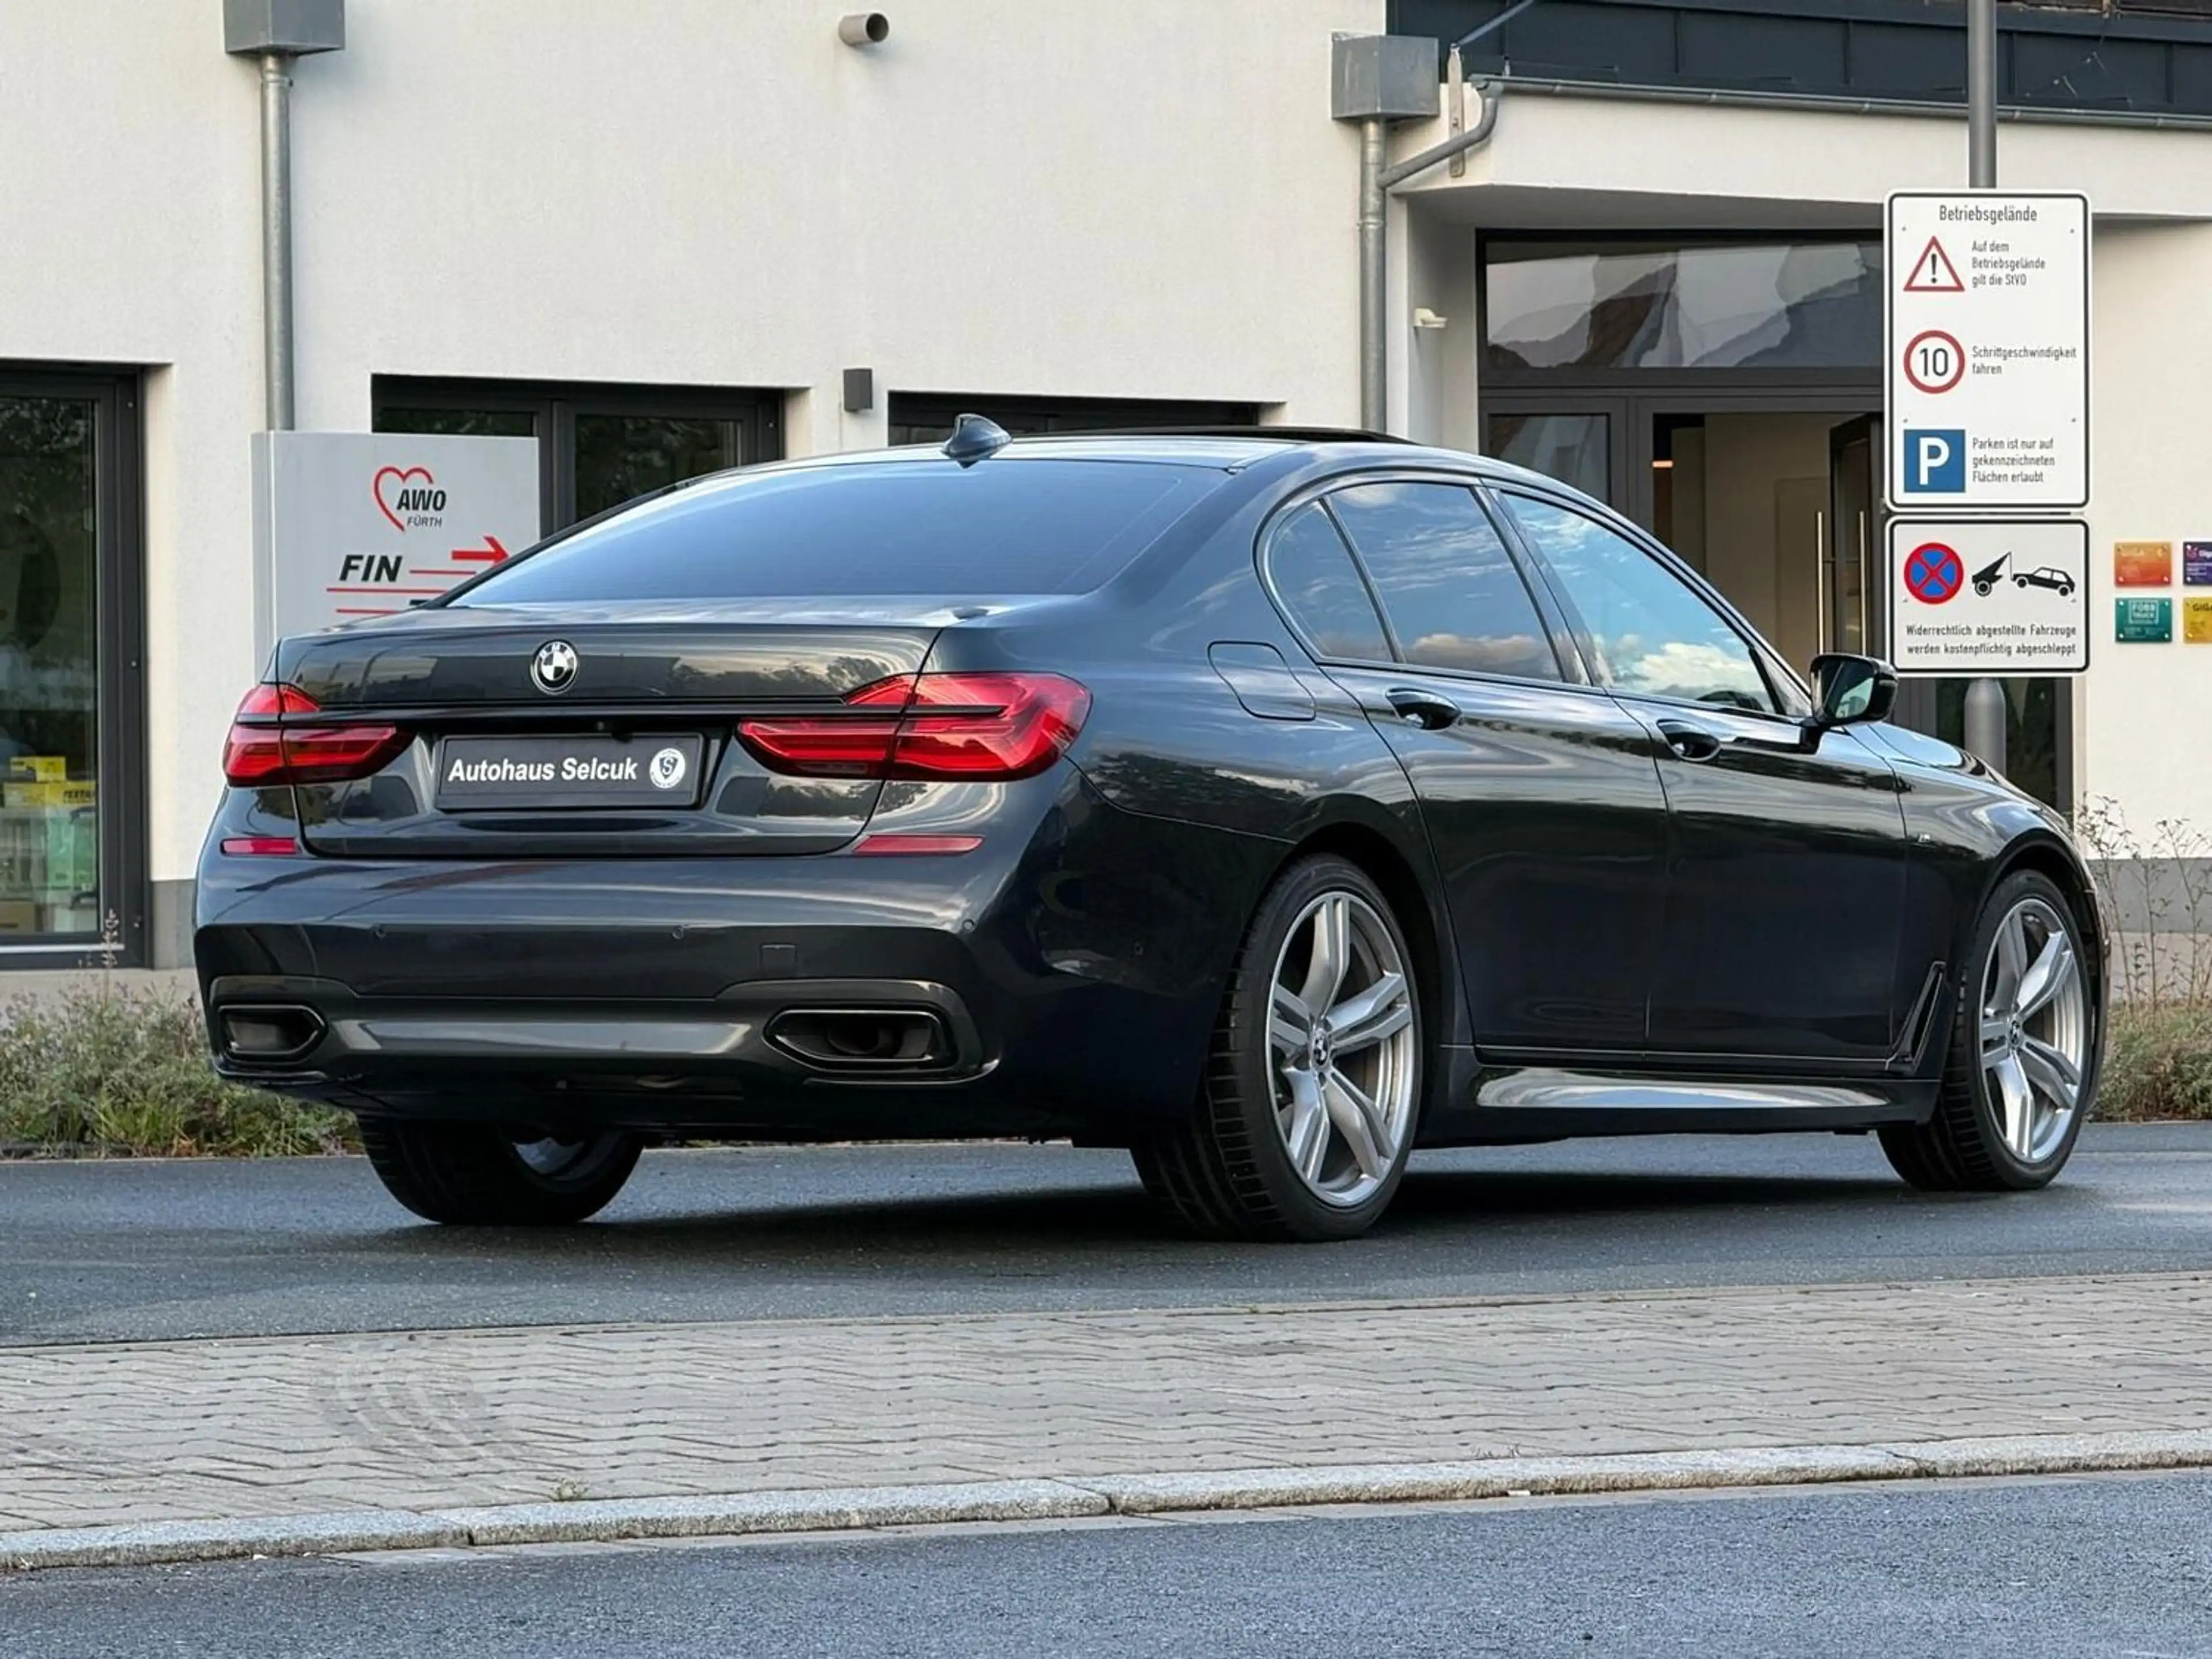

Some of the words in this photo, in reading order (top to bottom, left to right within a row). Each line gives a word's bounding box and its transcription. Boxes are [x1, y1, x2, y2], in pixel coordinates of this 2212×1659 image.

[1940, 204, 2037, 225] Betriebsgelände
[1972, 241, 1987, 252] Auf
[1990, 241, 2009, 252] dem
[1972, 257, 2046, 271] Betriebsgelände
[1972, 274, 1986, 288] gilt
[1989, 274, 2002, 285] die
[2005, 274, 2027, 286] StVO
[1972, 346, 2076, 361] Schrittgeschwindigkeit
[1918, 347, 1950, 377] 10
[1972, 363, 2002, 374] fahren
[1972, 437, 2005, 449] Parken
[2007, 439, 2018, 449] ist
[2021, 441, 2036, 449] nur
[2039, 438, 2054, 449] auf
[1918, 436, 1951, 486] P
[1973, 454, 2055, 468] gekennzeichneten
[1972, 471, 2008, 482] Flächen
[2012, 471, 2043, 482] erlaubt
[396, 489, 446, 512] AWO
[407, 515, 442, 527] FÜRTH
[339, 555, 403, 582] FIN
[1907, 625, 1972, 636] Widerrechtlich
[1976, 625, 2026, 638] abgestellte
[2030, 624, 2076, 638] Fahrzeuge
[1907, 643, 1940, 654] werden
[1944, 643, 2012, 657] kostenpflichtig
[2016, 643, 2075, 657] abgeschleppt
[448, 759, 555, 781] Autohaus
[561, 757, 638, 780] Selcuk
